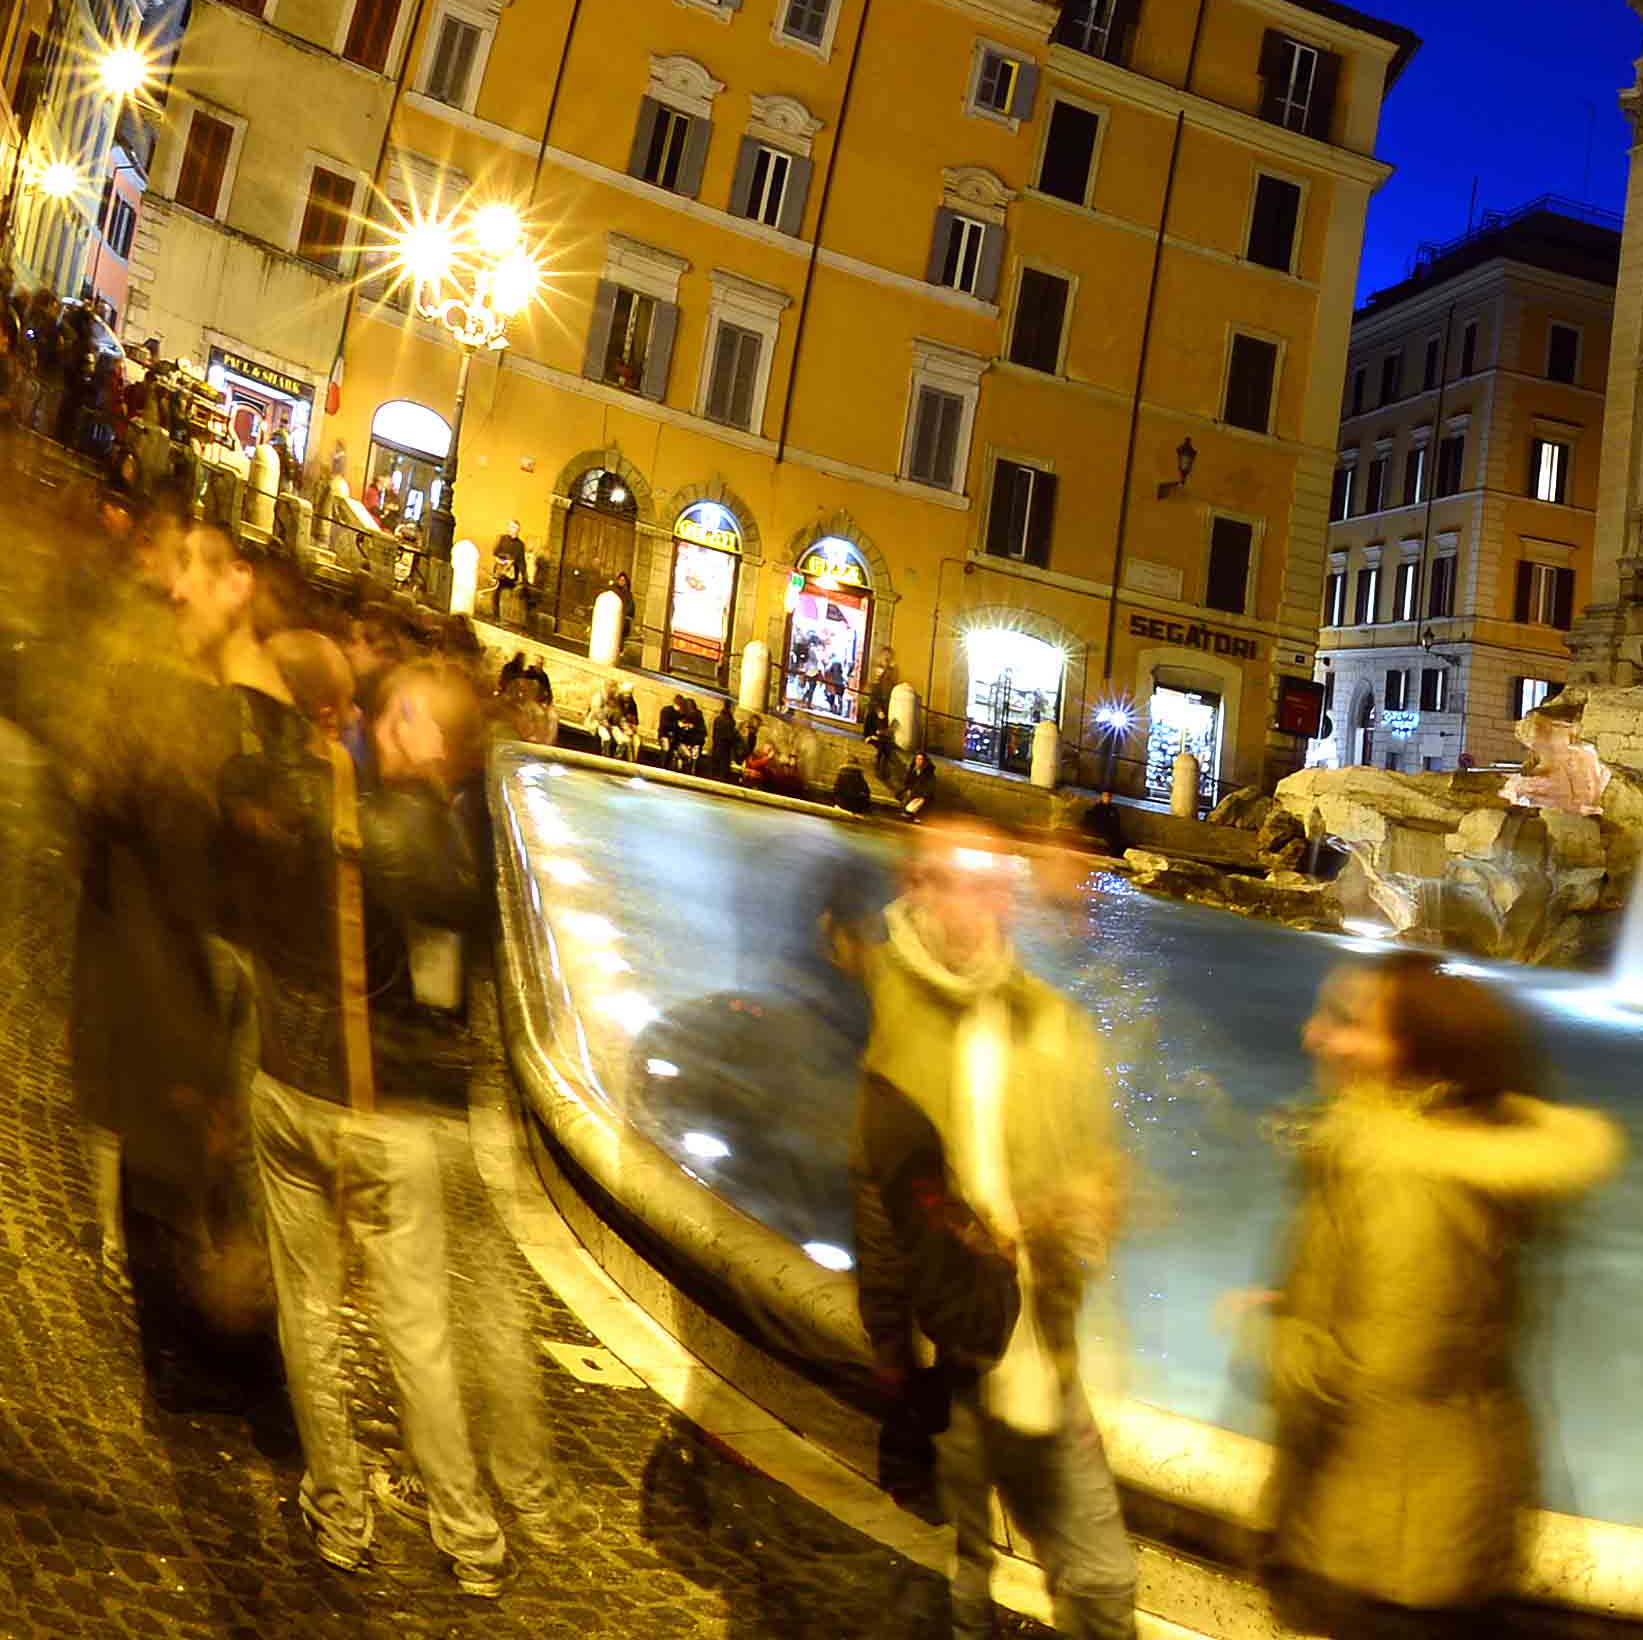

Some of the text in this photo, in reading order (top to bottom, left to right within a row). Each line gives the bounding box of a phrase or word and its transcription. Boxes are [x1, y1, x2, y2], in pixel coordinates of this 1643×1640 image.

[223, 353, 251, 373] PAUL
[262, 371, 301, 394] SHARK
[1129, 612, 1258, 661] SEGATORI
